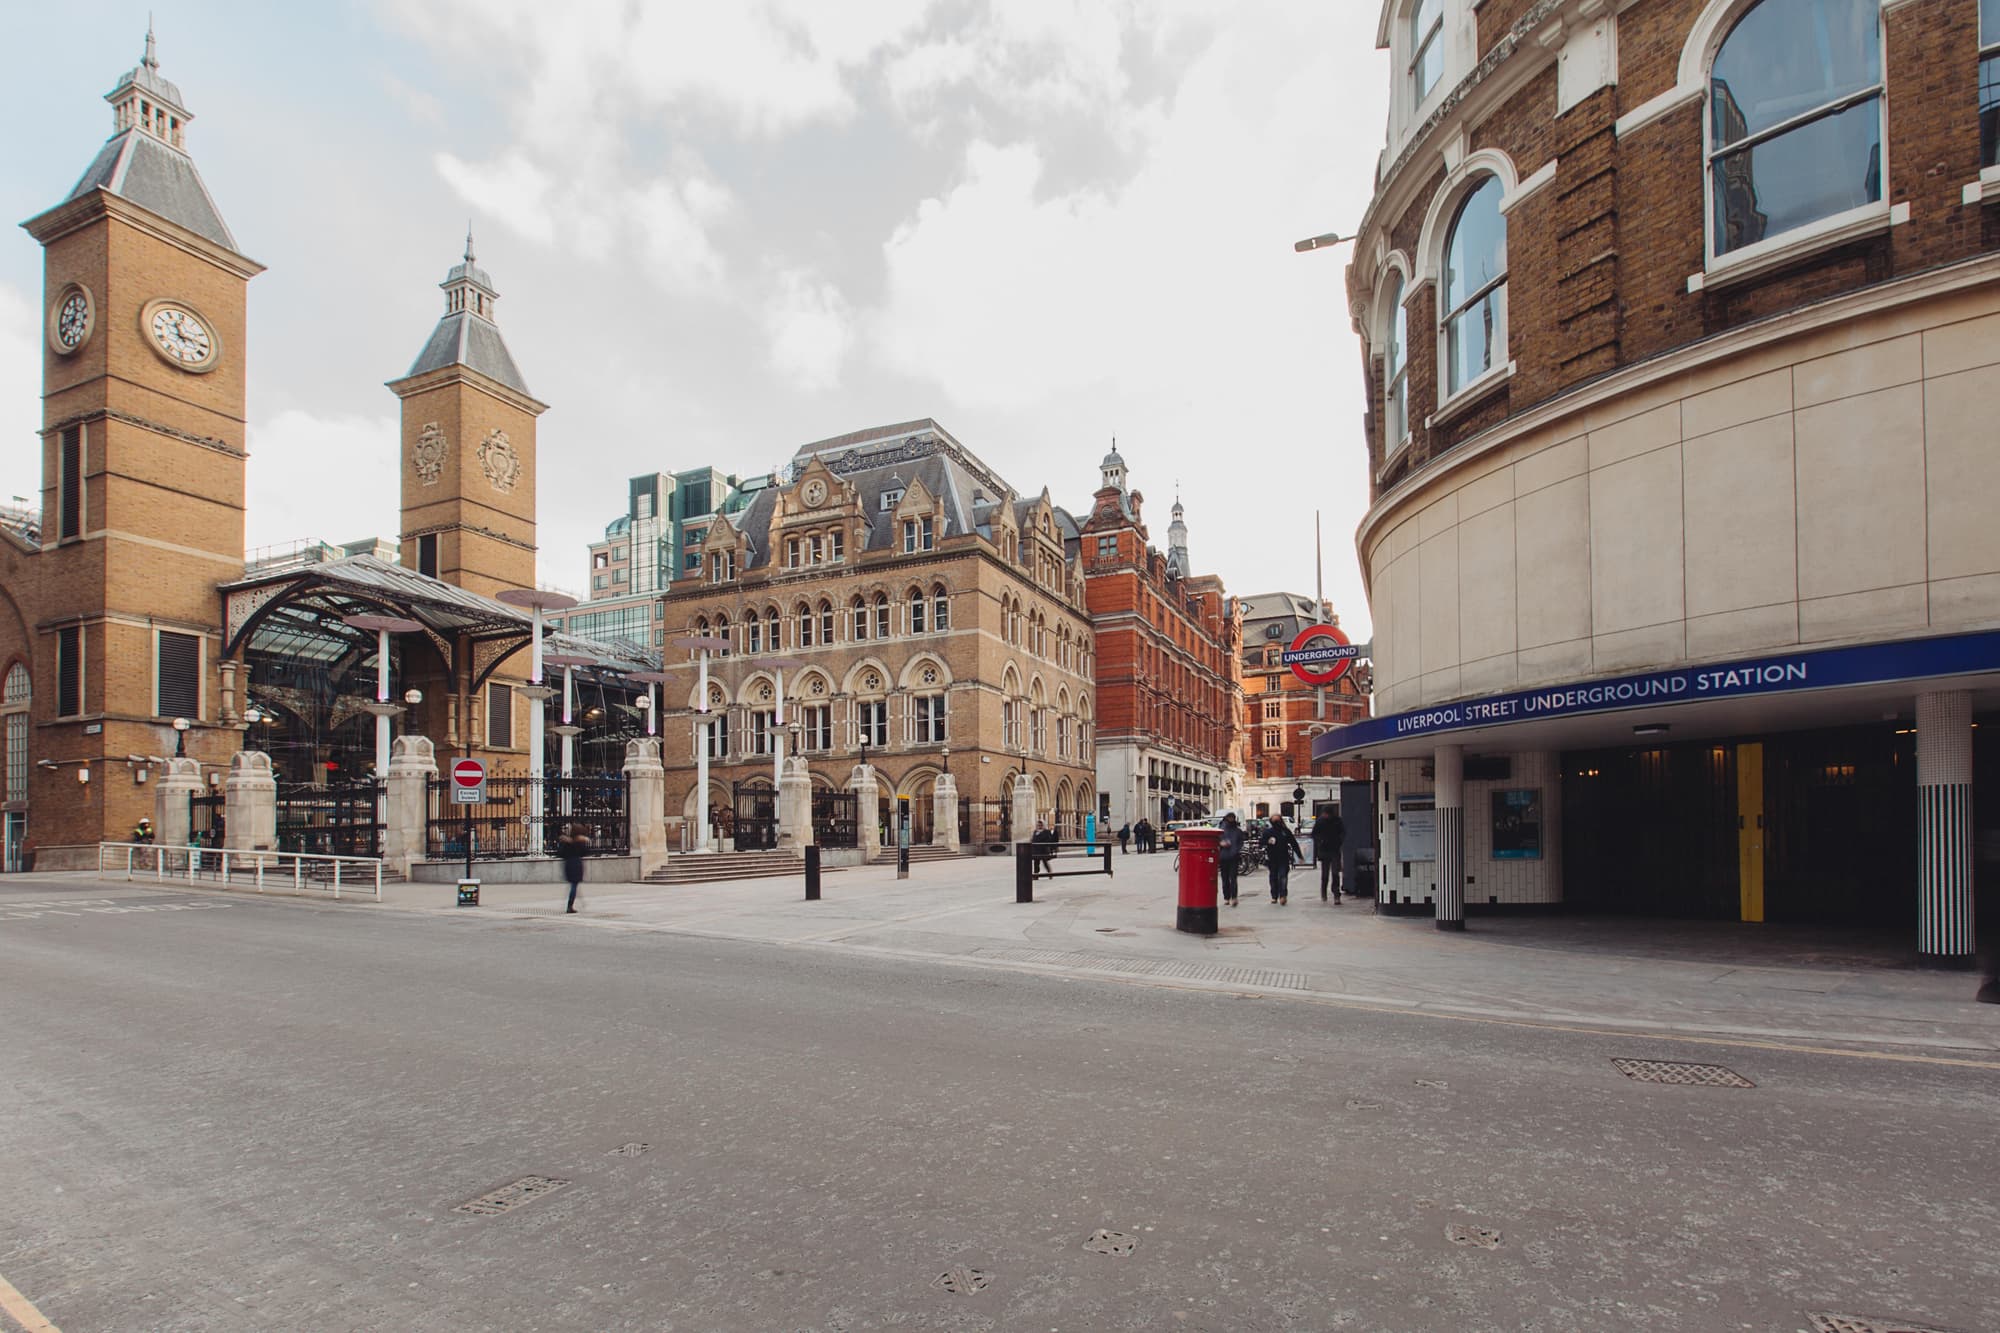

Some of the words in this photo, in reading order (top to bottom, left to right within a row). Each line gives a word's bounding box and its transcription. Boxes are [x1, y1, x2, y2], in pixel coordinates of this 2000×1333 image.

[1284, 647, 1356, 662] UNDERGROUND
[1398, 708, 1461, 732] LIVERPOOL
[1465, 699, 1519, 720] STREET
[1524, 676, 1687, 713] UNDERGROUND
[1697, 662, 1806, 690] STATION
